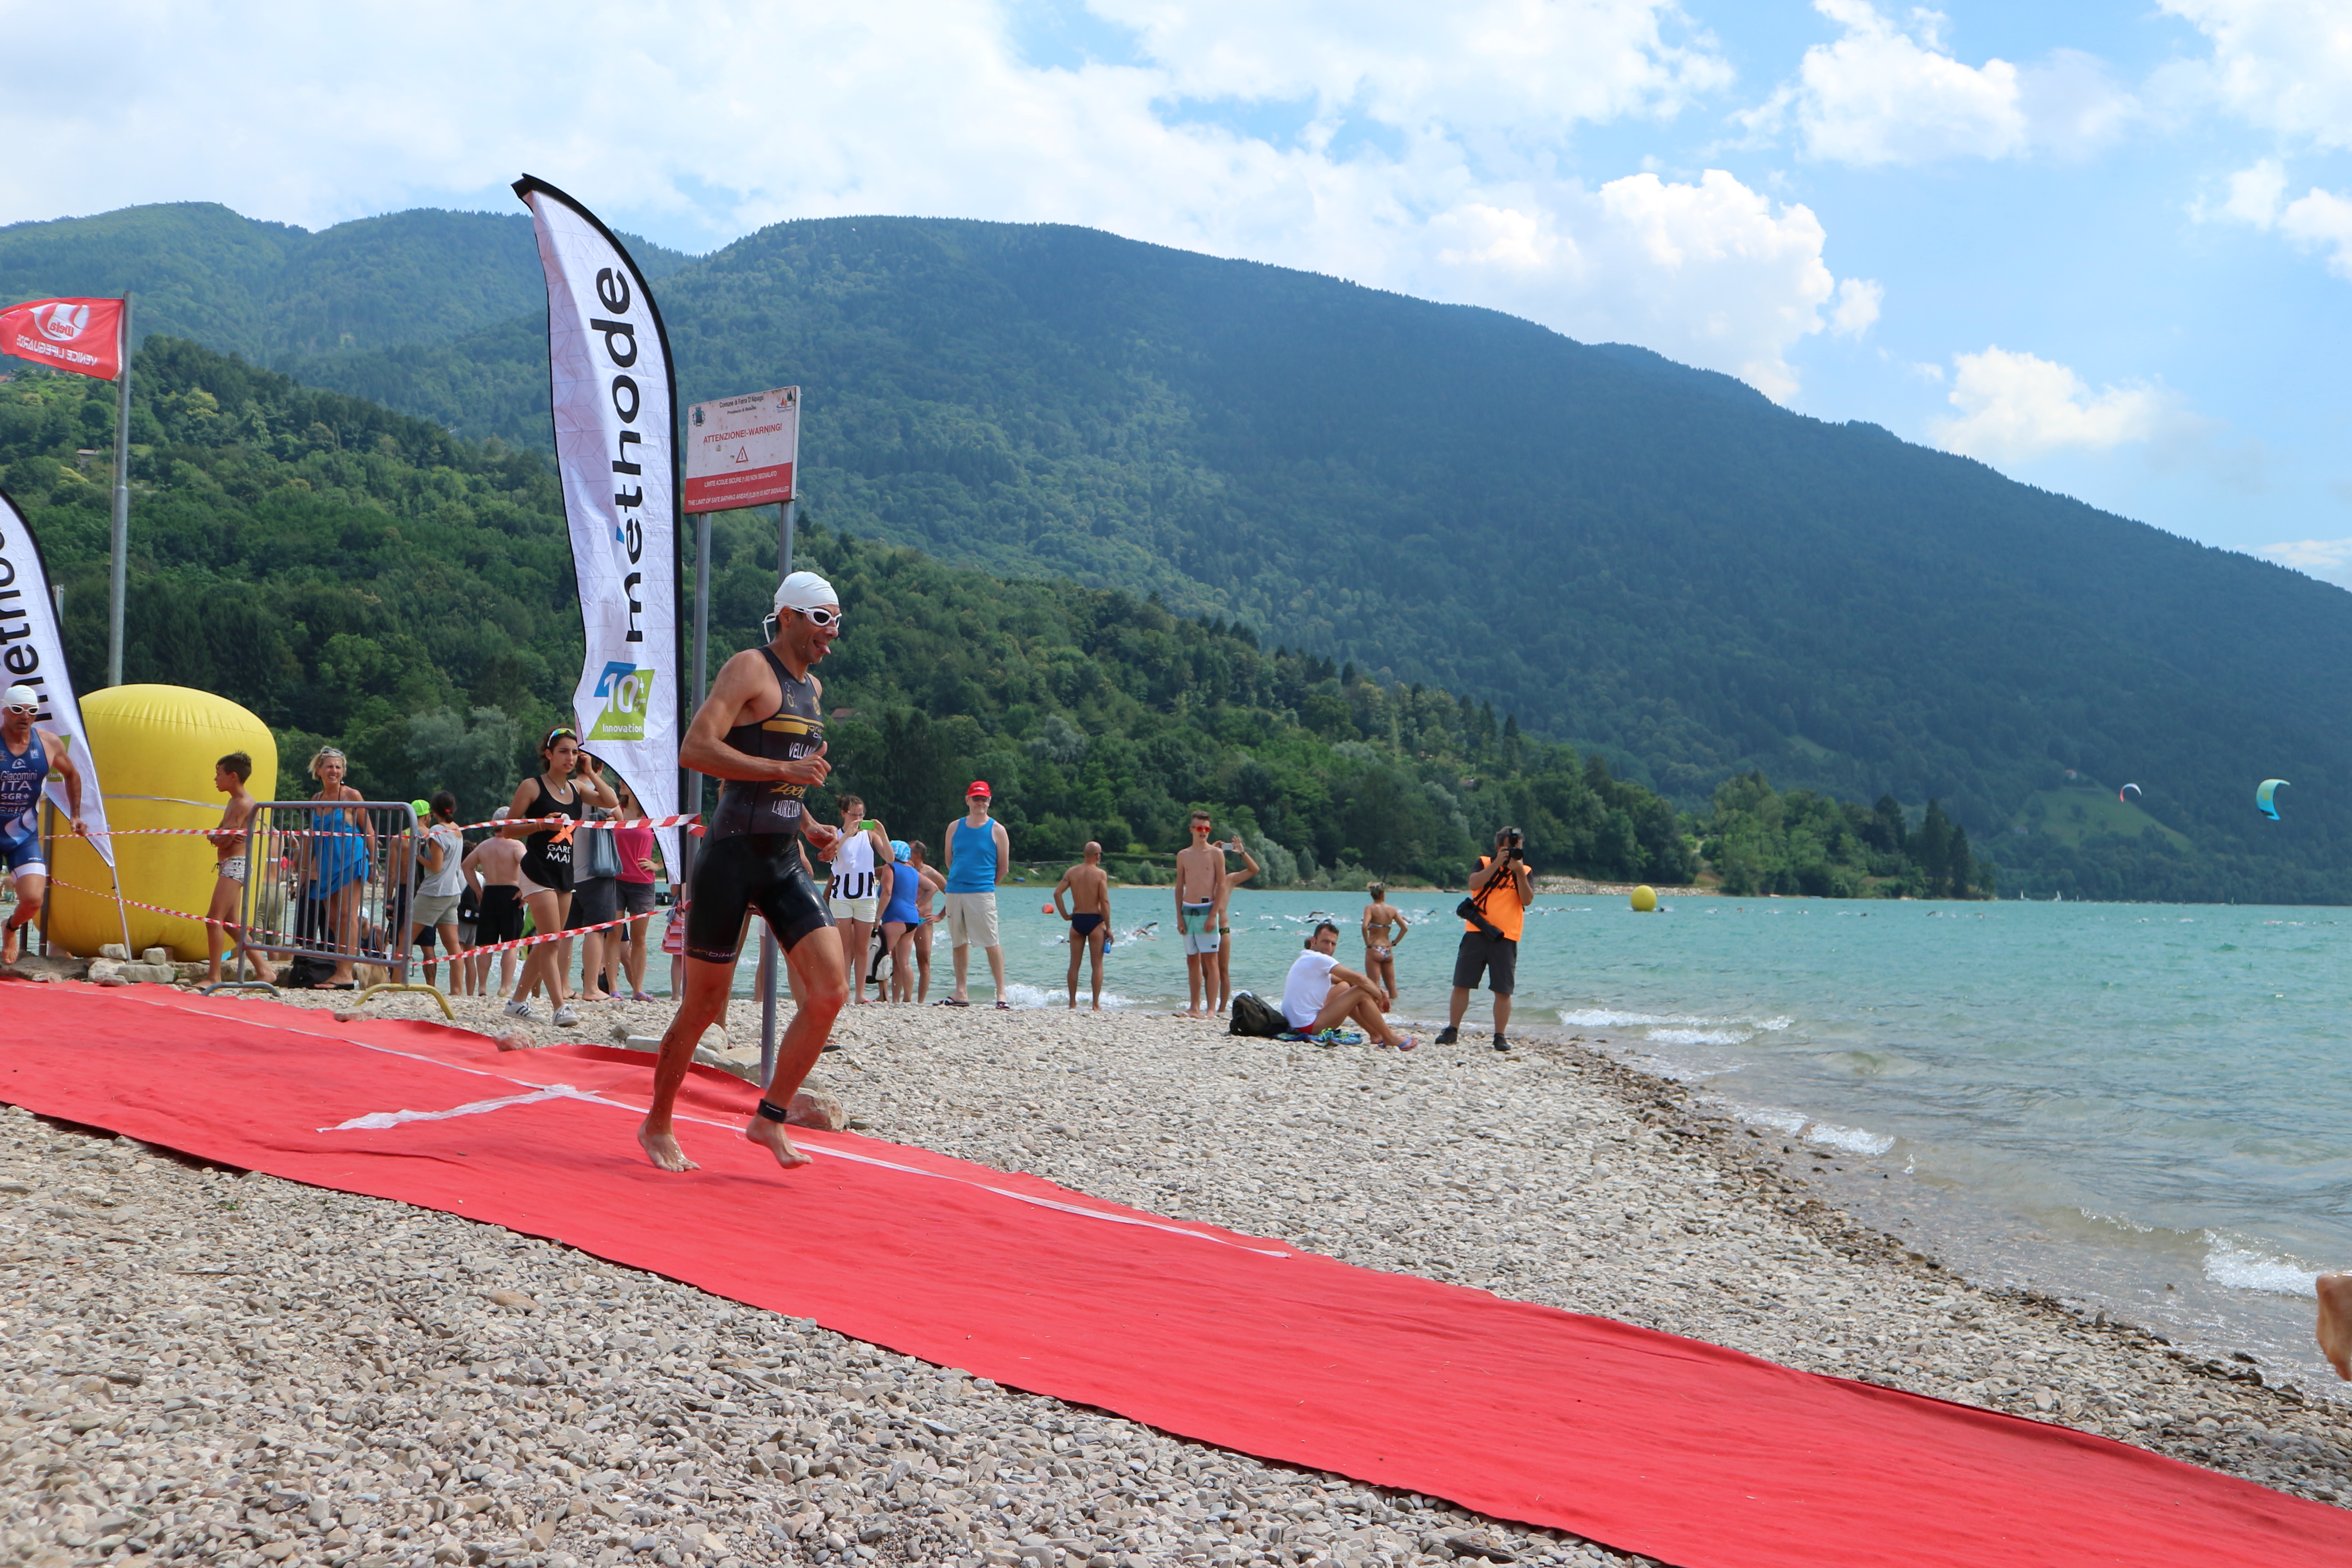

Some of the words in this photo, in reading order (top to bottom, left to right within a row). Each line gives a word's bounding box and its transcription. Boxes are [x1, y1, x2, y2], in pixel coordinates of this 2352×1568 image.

[589, 267, 643, 643] méthode
[758, 470, 777, 480] SEGNALATO
[770, 485, 789, 494] SIGNALLED
[602, 723, 643, 733] Innovation
[0, 770, 37, 781] Giacomini
[1, 780, 32, 791] ITA
